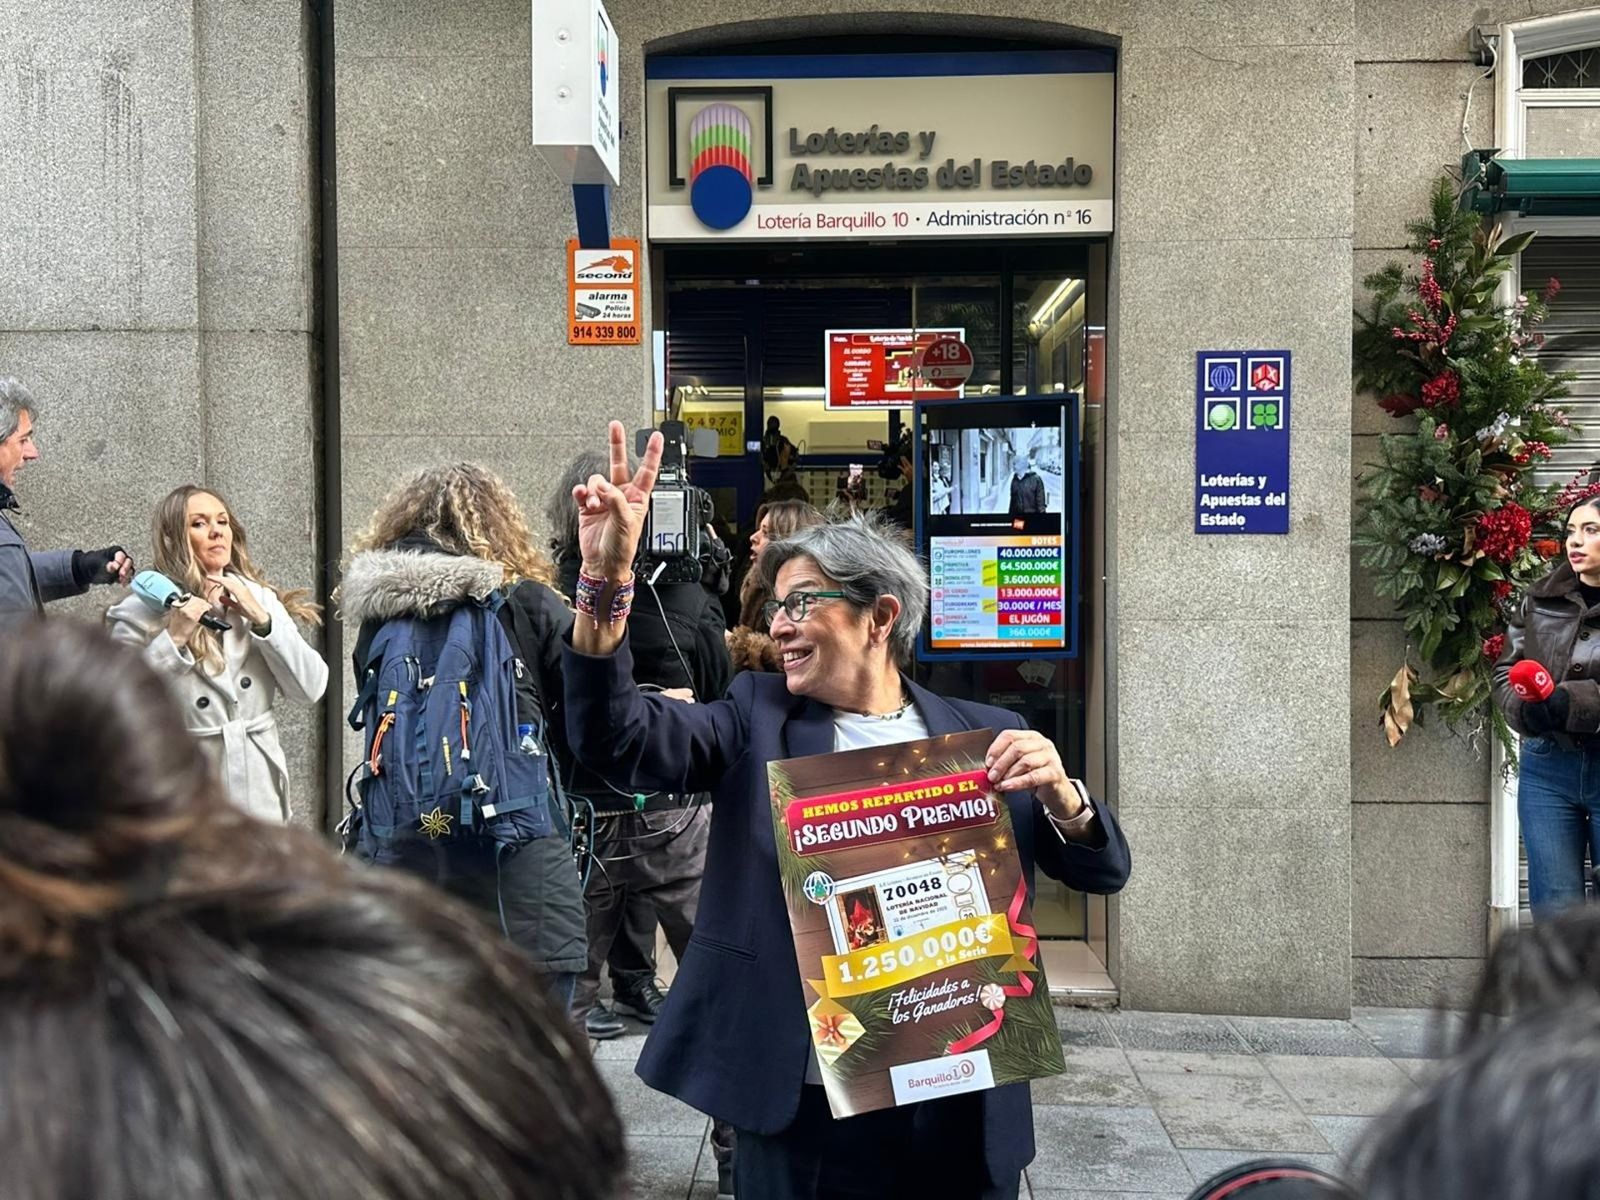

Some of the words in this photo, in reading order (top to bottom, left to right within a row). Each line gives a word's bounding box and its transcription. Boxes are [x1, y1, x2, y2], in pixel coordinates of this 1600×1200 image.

[789, 124, 909, 156] Loterías
[917, 131, 936, 160] y
[791, 161, 929, 197] Apuestas
[936, 158, 981, 189] del
[991, 157, 1093, 189] Estado
[758, 212, 811, 229] Lotería
[817, 212, 886, 231] Barquillo
[893, 212, 908, 227] 10
[927, 208, 1048, 227] Administración
[1077, 209, 1092, 225] 16
[577, 272, 632, 280] second
[588, 292, 627, 300] alarma
[573, 326, 592, 338] 914
[595, 326, 614, 338] 339
[617, 326, 636, 338] 800
[932, 343, 960, 360] +18
[1200, 473, 1255, 487] Loterías
[1258, 476, 1267, 490] y
[1200, 493, 1262, 509] Apuestas
[1264, 492, 1286, 506] del
[1200, 512, 1246, 526] Estado
[1031, 536, 1058, 545] BOTES
[1000, 548, 1058, 557] 40.000.000€
[1000, 562, 1058, 570] 64.500.000€
[1003, 575, 1056, 584] 3.600.000€
[1001, 588, 1058, 597] 13.000.000€
[998, 602, 1035, 611] 30.000€
[1043, 601, 1061, 610] MES
[1009, 615, 1020, 623] EL
[1021, 612, 1050, 624] JUGÓN
[802, 800, 859, 819] HEMOS
[863, 784, 954, 809] REPARTIDO
[959, 780, 979, 793] EL
[794, 814, 898, 852] ¡SEGUNDO
[901, 799, 996, 829] PREMIO!
[883, 877, 942, 901] 70048
[886, 900, 913, 911] LOTERÍA
[915, 893, 947, 904] NACIONAL
[909, 902, 938, 912] NAVIDAD
[838, 923, 993, 984] 1.250.000€
[945, 954, 957, 964] la
[959, 946, 987, 961] Serie
[888, 978, 958, 1010] ¡Felicidades
[961, 979, 970, 988] a
[892, 1009, 910, 1024] los
[913, 985, 981, 1024] Ganadores!
